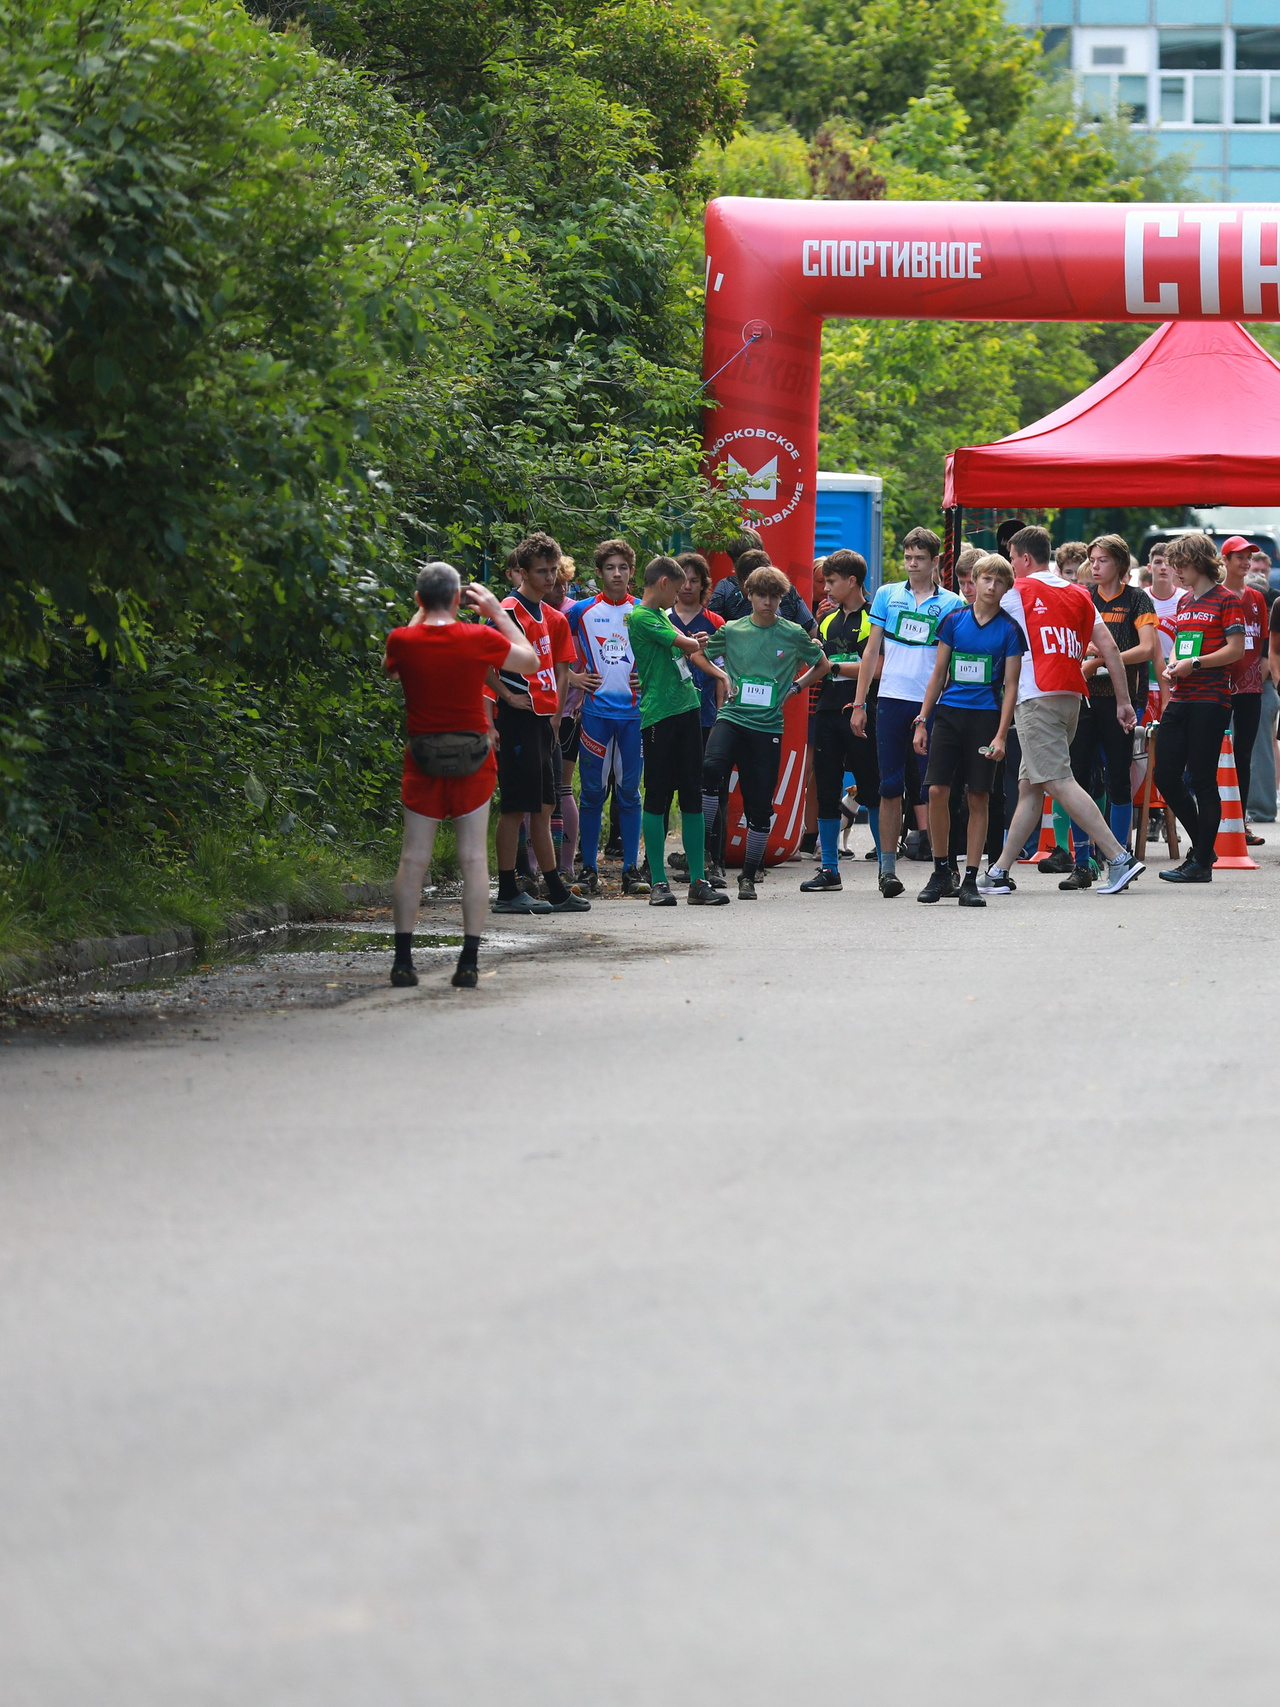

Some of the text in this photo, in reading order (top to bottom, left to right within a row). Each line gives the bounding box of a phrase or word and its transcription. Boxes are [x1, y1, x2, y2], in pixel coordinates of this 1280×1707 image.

[803, 240, 982, 279] СПОРТИВНОЕ
[710, 428, 801, 458] МОСКОВСКОЕ
[1203, 611, 1226, 623] WEST
[905, 623, 924, 634] 118.1
[960, 666, 978, 674] 107.1
[747, 686, 765, 695] 119.1
